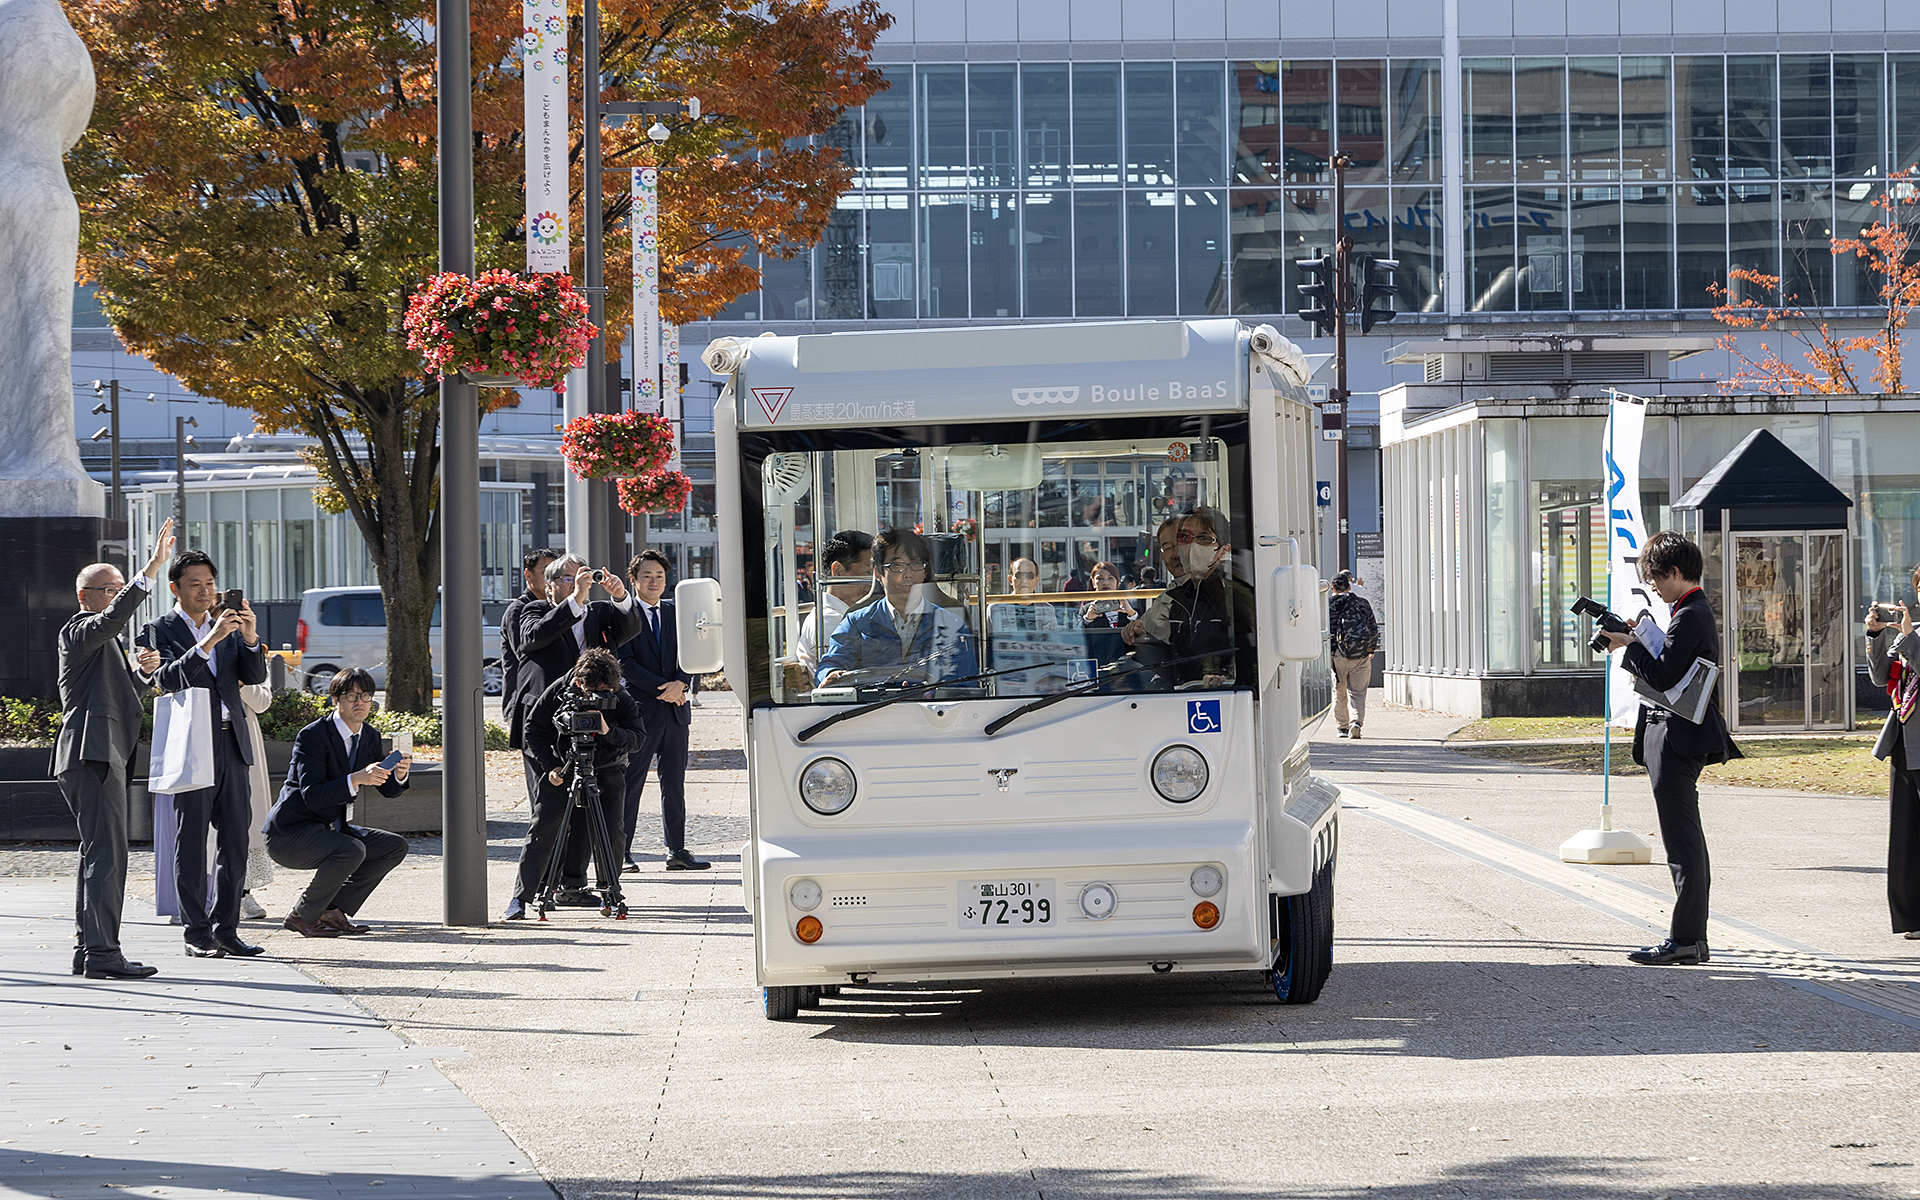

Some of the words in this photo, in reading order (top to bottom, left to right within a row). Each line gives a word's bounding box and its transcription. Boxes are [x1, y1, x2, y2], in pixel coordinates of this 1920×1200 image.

[542, 94, 551, 196] こどもまんなかを広げよう
[1091, 383, 1160, 404] Boule
[1168, 380, 1228, 400] BaaS
[789, 400, 916, 422] 最高速度20km/h未満
[963, 906, 977, 920] ふ
[979, 898, 1051, 925] 72-99
